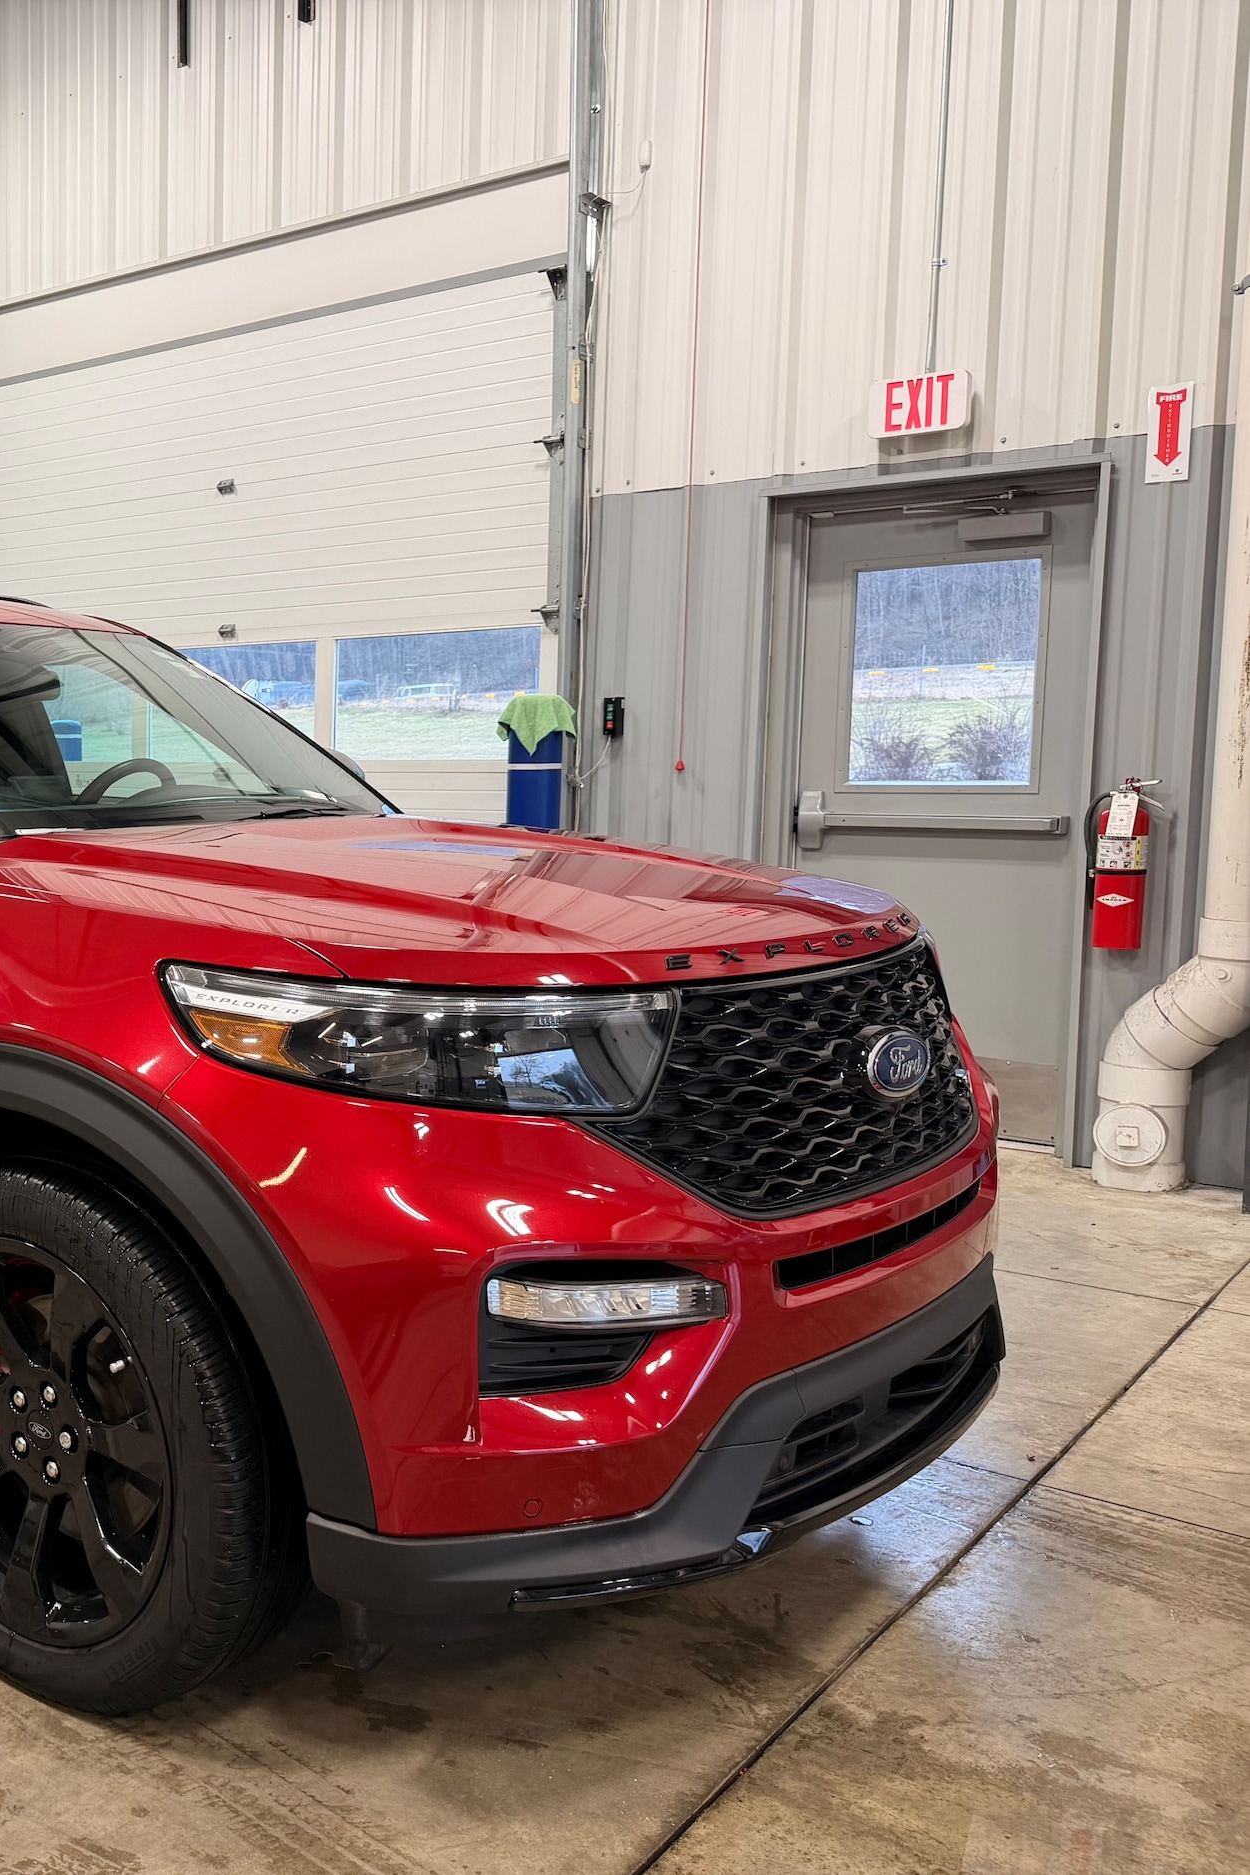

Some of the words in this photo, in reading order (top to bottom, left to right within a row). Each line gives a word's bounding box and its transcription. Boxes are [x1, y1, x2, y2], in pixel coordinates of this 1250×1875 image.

[883, 373, 955, 433] EXIT
[1159, 393, 1183, 403] FIRE
[1165, 403, 1173, 463] EXTINGUISHER
[665, 912, 911, 971] EXPLORER
[195, 993, 300, 1016] EXPLORER
[889, 1042, 925, 1084] Ford
